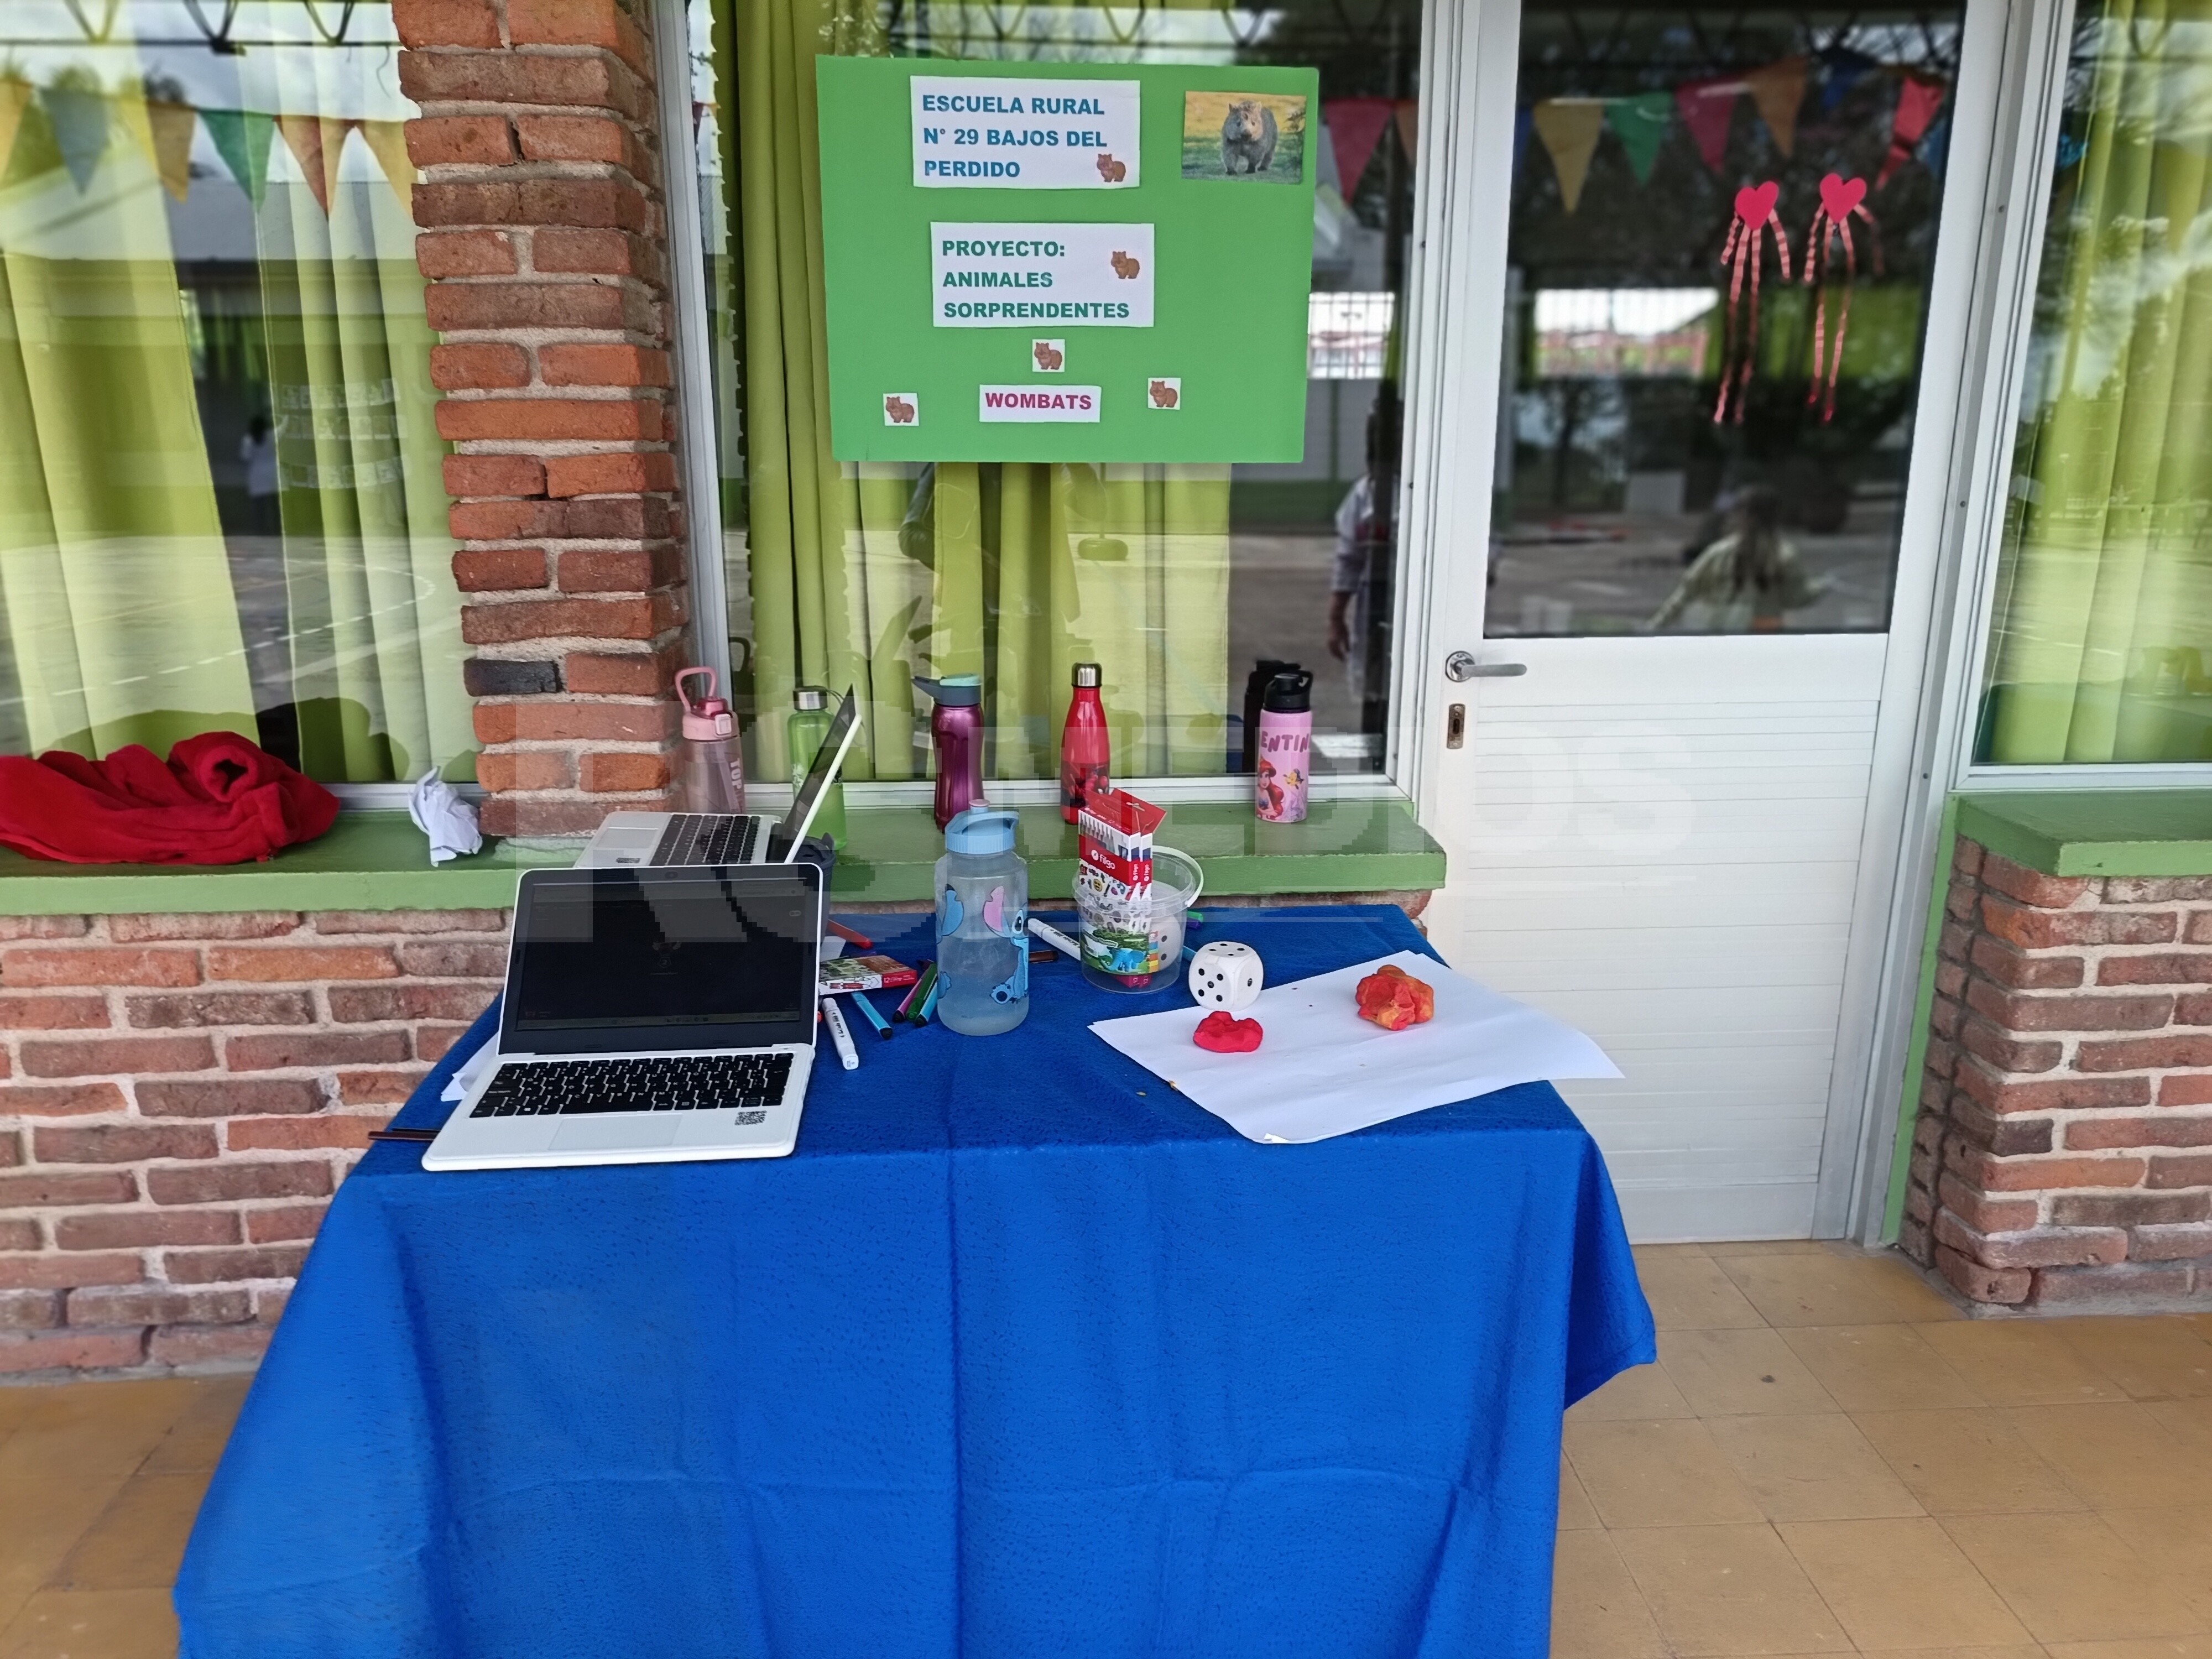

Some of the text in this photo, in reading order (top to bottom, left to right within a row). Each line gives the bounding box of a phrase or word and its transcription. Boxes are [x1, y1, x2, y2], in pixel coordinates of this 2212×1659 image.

[922, 94, 1105, 116] ESCUELA RURAL
[953, 128, 979, 145] 29
[986, 128, 1060, 147] BAJOS
[1066, 131, 1108, 148] DEL
[924, 159, 1021, 178] PERDIDO
[942, 239, 1065, 258] PROYECTO:
[942, 271, 1053, 288] ANIMALES
[943, 302, 1130, 319] SORPRENDENTES
[984, 392, 1092, 410] WOMBATS
[729, 757, 743, 790] TOP
[1099, 853, 1116, 870] filgo
